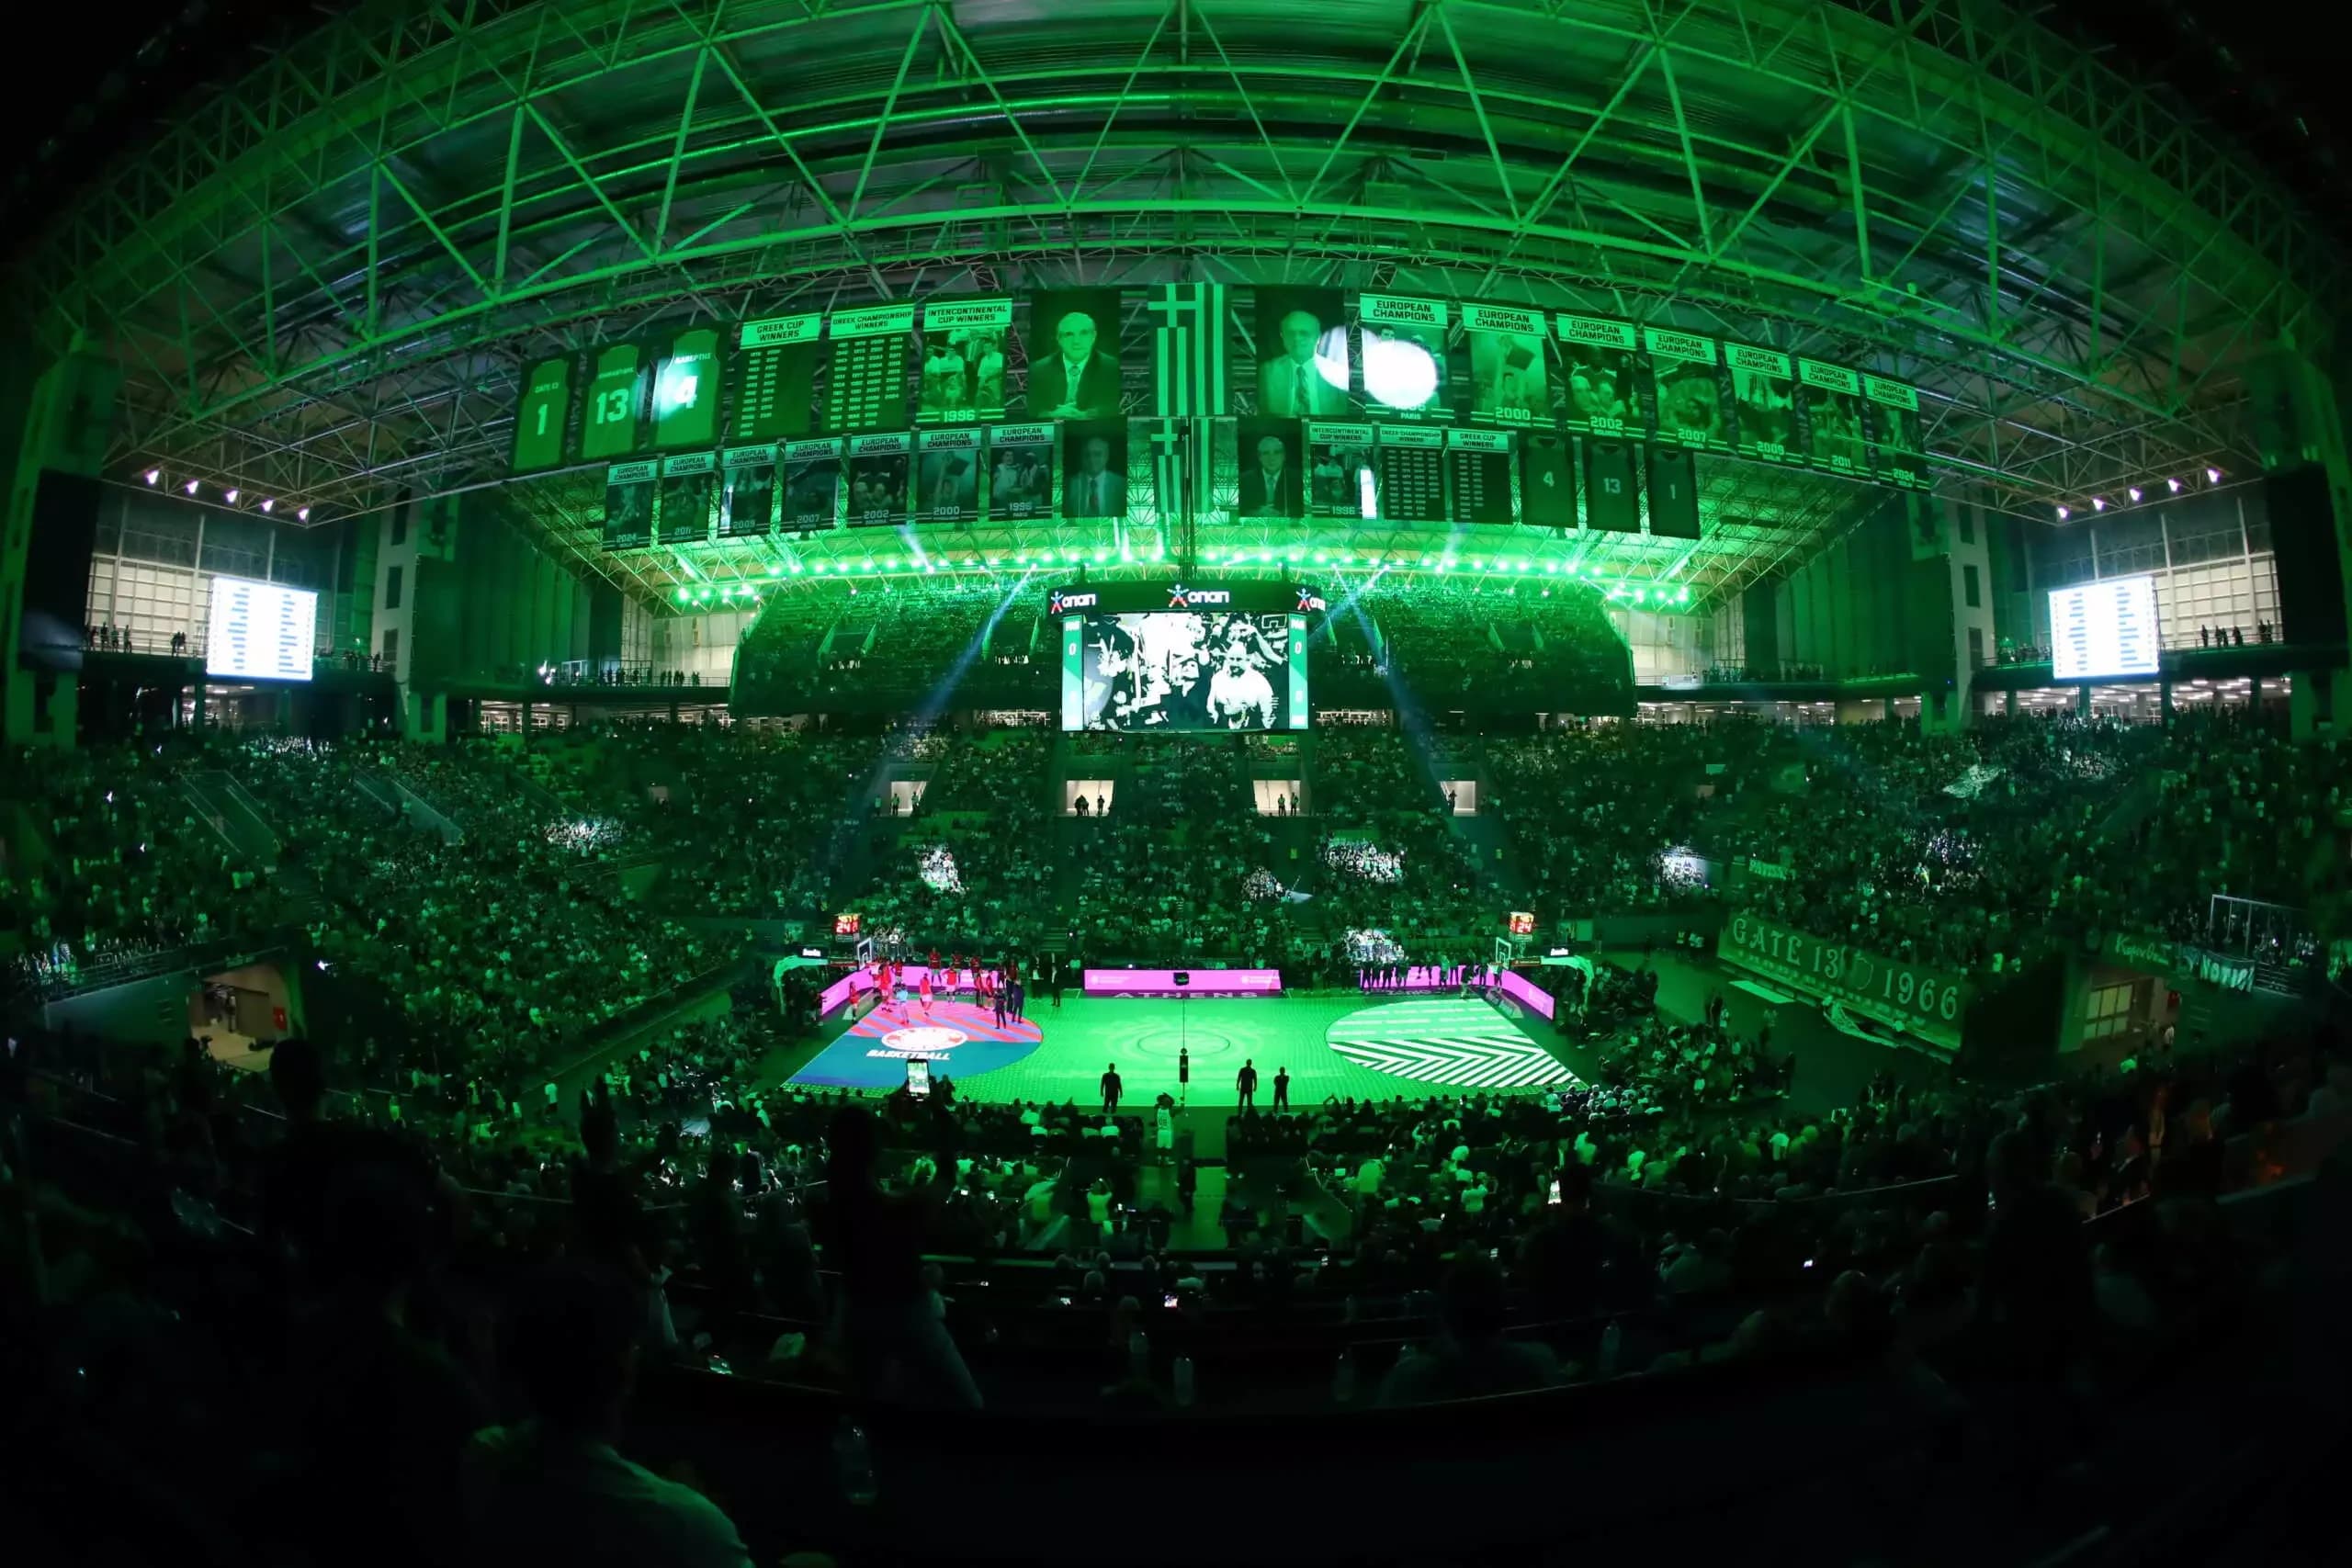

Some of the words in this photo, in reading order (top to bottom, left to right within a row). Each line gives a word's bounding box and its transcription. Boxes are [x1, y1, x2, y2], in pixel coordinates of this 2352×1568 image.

[928, 305, 1007, 316] INTERCONTINENTAL
[1377, 300, 1430, 312] EUROPEAN
[832, 315, 853, 326] GREEK
[854, 310, 912, 323] CHAMPIONSHIP
[937, 314, 954, 323] CUP
[956, 313, 996, 323] WINNERS
[1373, 309, 1435, 321] CHAMPIONS
[1477, 310, 1530, 322] EUROPEAN
[757, 322, 785, 333] GREEK
[786, 320, 805, 331] CUP
[854, 320, 888, 330] WINNERS
[1475, 318, 1534, 333] CHAMPIONS
[1571, 320, 1621, 333] EUROPEAN
[759, 329, 800, 342] WINNERS
[1569, 329, 1624, 344] CHAMPIONS
[1657, 334, 1702, 348] EUROPEAN
[1656, 343, 1707, 358] CHAMPIONS
[1736, 349, 1779, 364] EUROPEAN
[1736, 357, 1782, 373] CHAMPIONS
[1810, 365, 1848, 380] EUROPEAN
[1808, 373, 1851, 389] CHAMPIONS
[674, 376, 698, 409] 4
[1874, 381, 1907, 395] EUROPEAN
[1872, 389, 1911, 404] CHAMPIONS
[595, 389, 629, 424] 13
[537, 404, 548, 435] 1
[944, 410, 976, 423] 1996
[1401, 412, 1421, 420] PARIS
[1495, 407, 1531, 420] 2000
[1590, 416, 1623, 430] 2002
[1002, 426, 1043, 436] EUROPEAN
[1678, 428, 1706, 442] 2007
[862, 437, 899, 446] EUROPEAN
[927, 438, 972, 448] CHAMPIONS
[931, 433, 969, 442] EUROPEAN
[1000, 433, 1045, 443] CHAMPIONS
[1459, 433, 1478, 442] GREEK
[1480, 434, 1497, 442] CUP
[796, 442, 831, 451] EUROPEAN
[858, 443, 901, 452] CHAMPIONS
[1463, 440, 1495, 449] WINNERS
[1757, 441, 1785, 456] 2009
[732, 448, 767, 458] EUROPEAN
[792, 448, 833, 458] CHAMPIONS
[673, 457, 706, 466] EUROPEAN
[729, 455, 769, 465] CHAMPIONS
[1832, 456, 1851, 468] 2011
[670, 463, 707, 472] CHAMPIONS
[1543, 471, 1555, 488] 4
[1603, 477, 1622, 494] 13
[1669, 484, 1677, 500] 1
[864, 510, 889, 520] 2002
[933, 506, 960, 515] 2000
[797, 514, 820, 524] 2007
[836, 922, 851, 933] 24
[1516, 922, 1532, 933] 24
[1733, 919, 1802, 965] GATE
[1813, 946, 1838, 979] 13
[1883, 968, 1958, 1021] 1966
